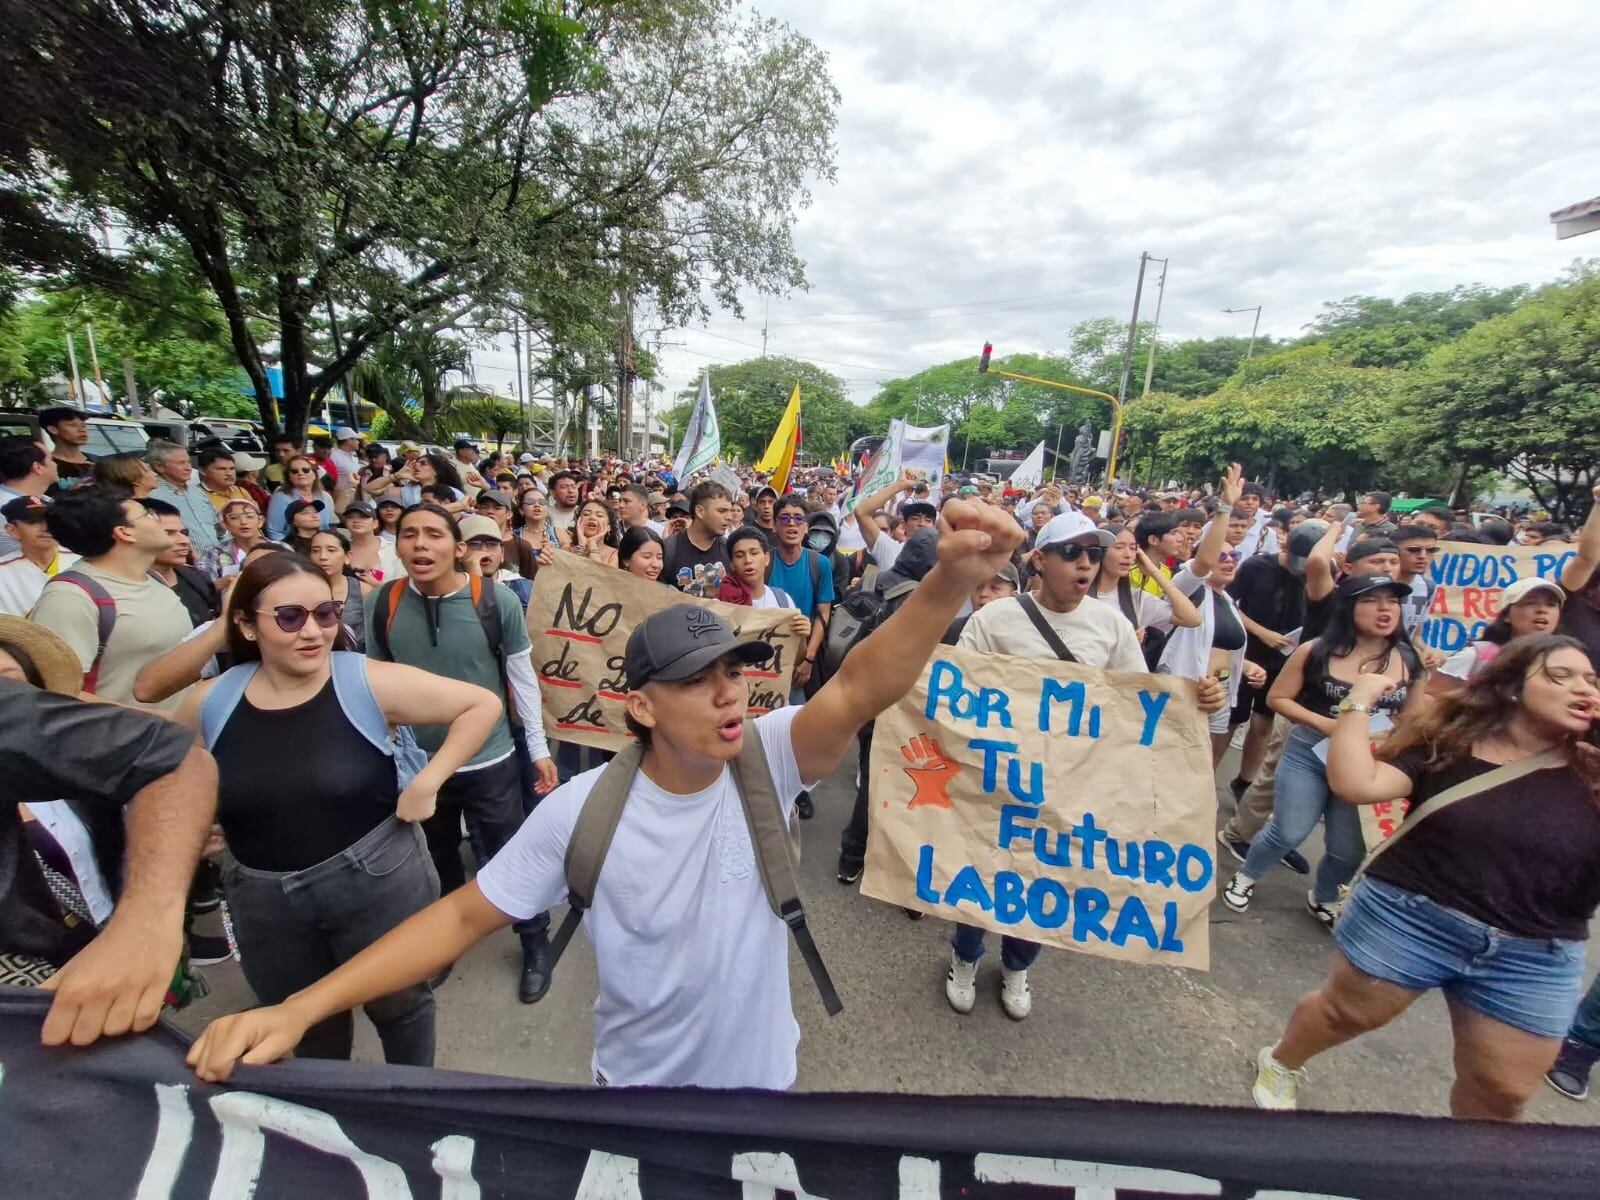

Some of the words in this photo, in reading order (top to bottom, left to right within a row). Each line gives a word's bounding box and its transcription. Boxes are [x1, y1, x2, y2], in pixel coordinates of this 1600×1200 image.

[925, 660, 1014, 729] POR
[1137, 689, 1171, 747] Y
[916, 845, 1184, 952] LABORAL
